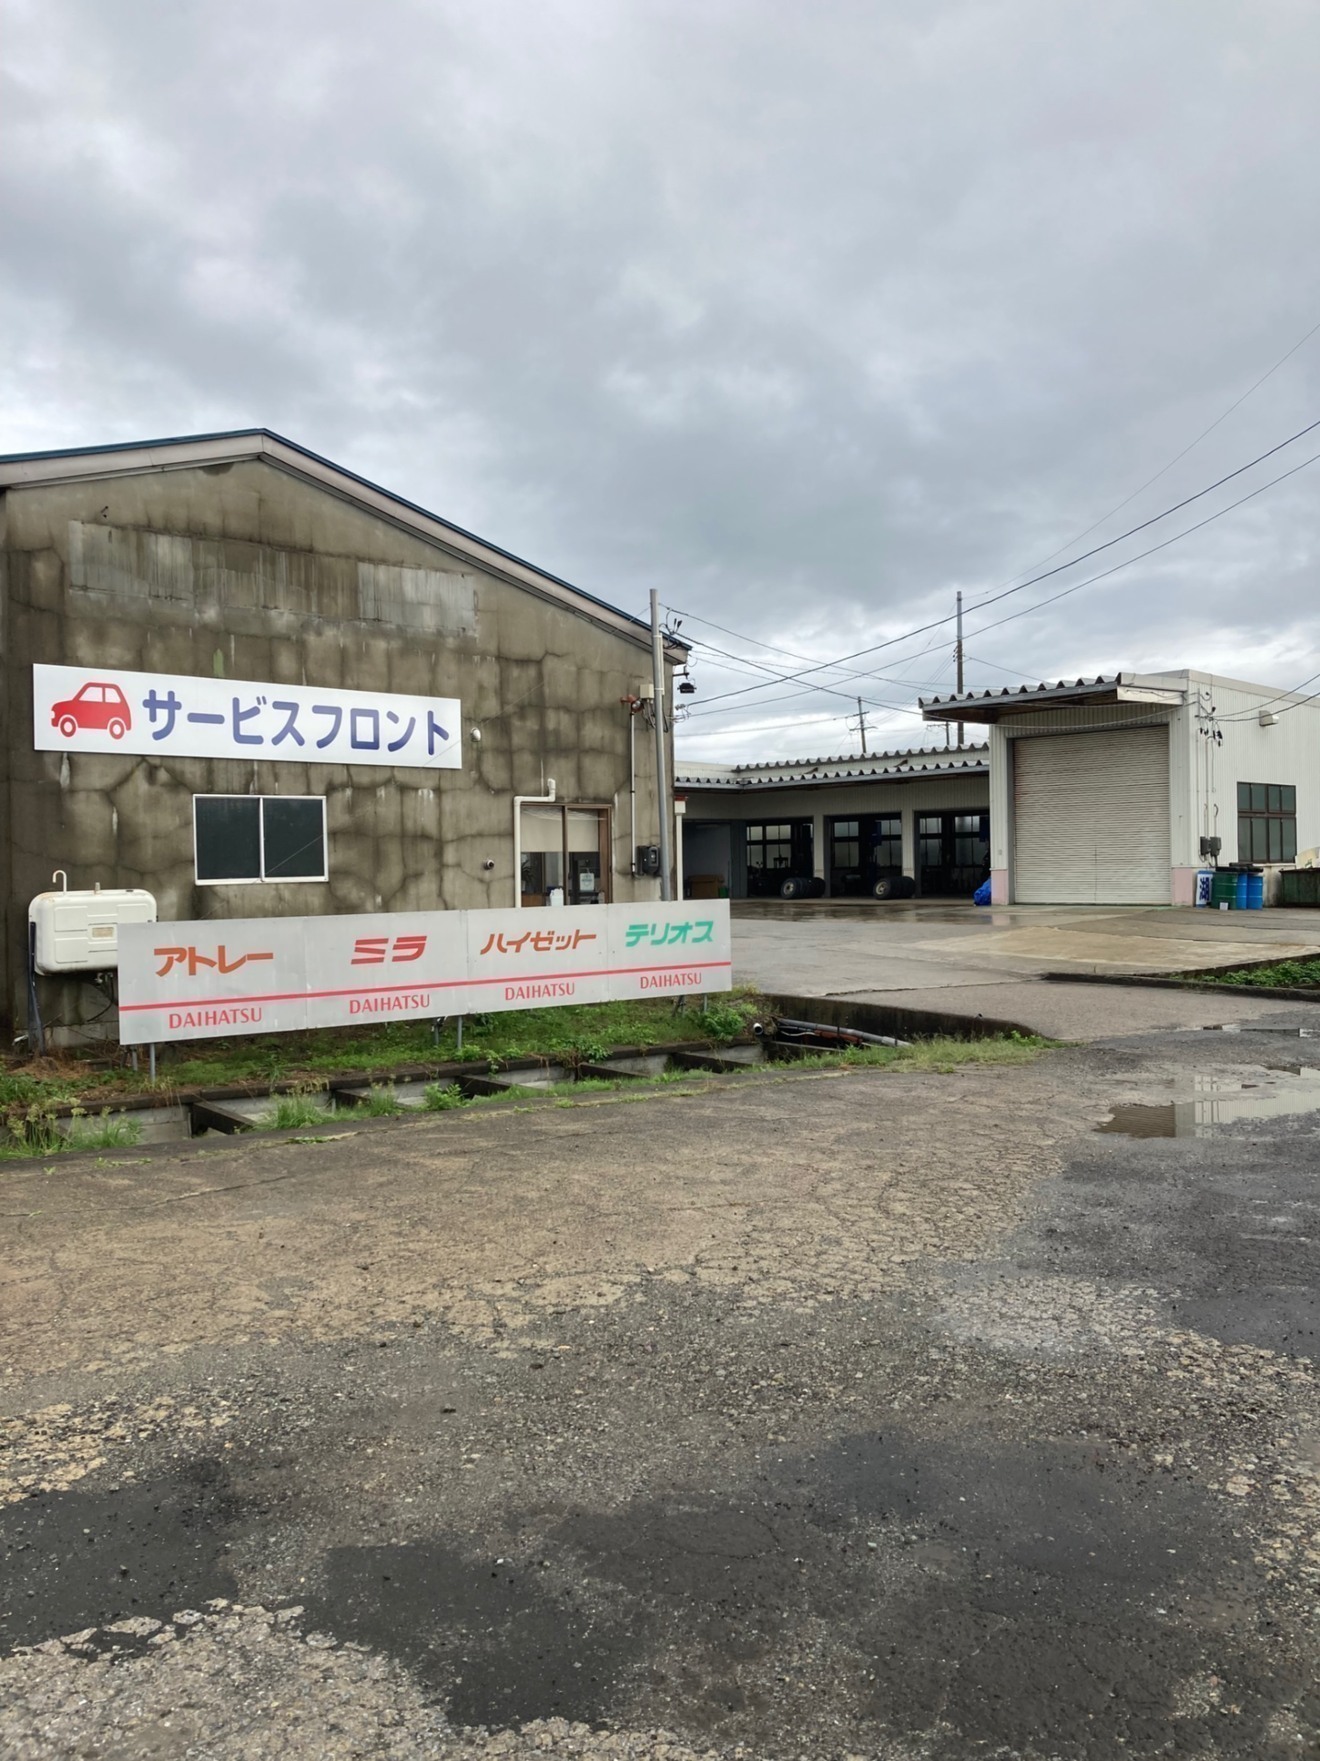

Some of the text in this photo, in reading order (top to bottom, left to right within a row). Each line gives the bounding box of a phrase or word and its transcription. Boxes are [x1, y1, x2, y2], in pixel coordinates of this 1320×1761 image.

[142, 689, 450, 756] サービスフロント
[480, 929, 597, 955] ハイゼット
[625, 920, 714, 948] テリオス
[154, 945, 274, 978] アトレー
[351, 935, 427, 965] ミラ
[504, 982, 576, 1001] DAIHATSU
[639, 972, 702, 989] DAIHATSU
[349, 993, 431, 1015] DAIHATSU
[168, 1007, 263, 1030] DAIHATSU
